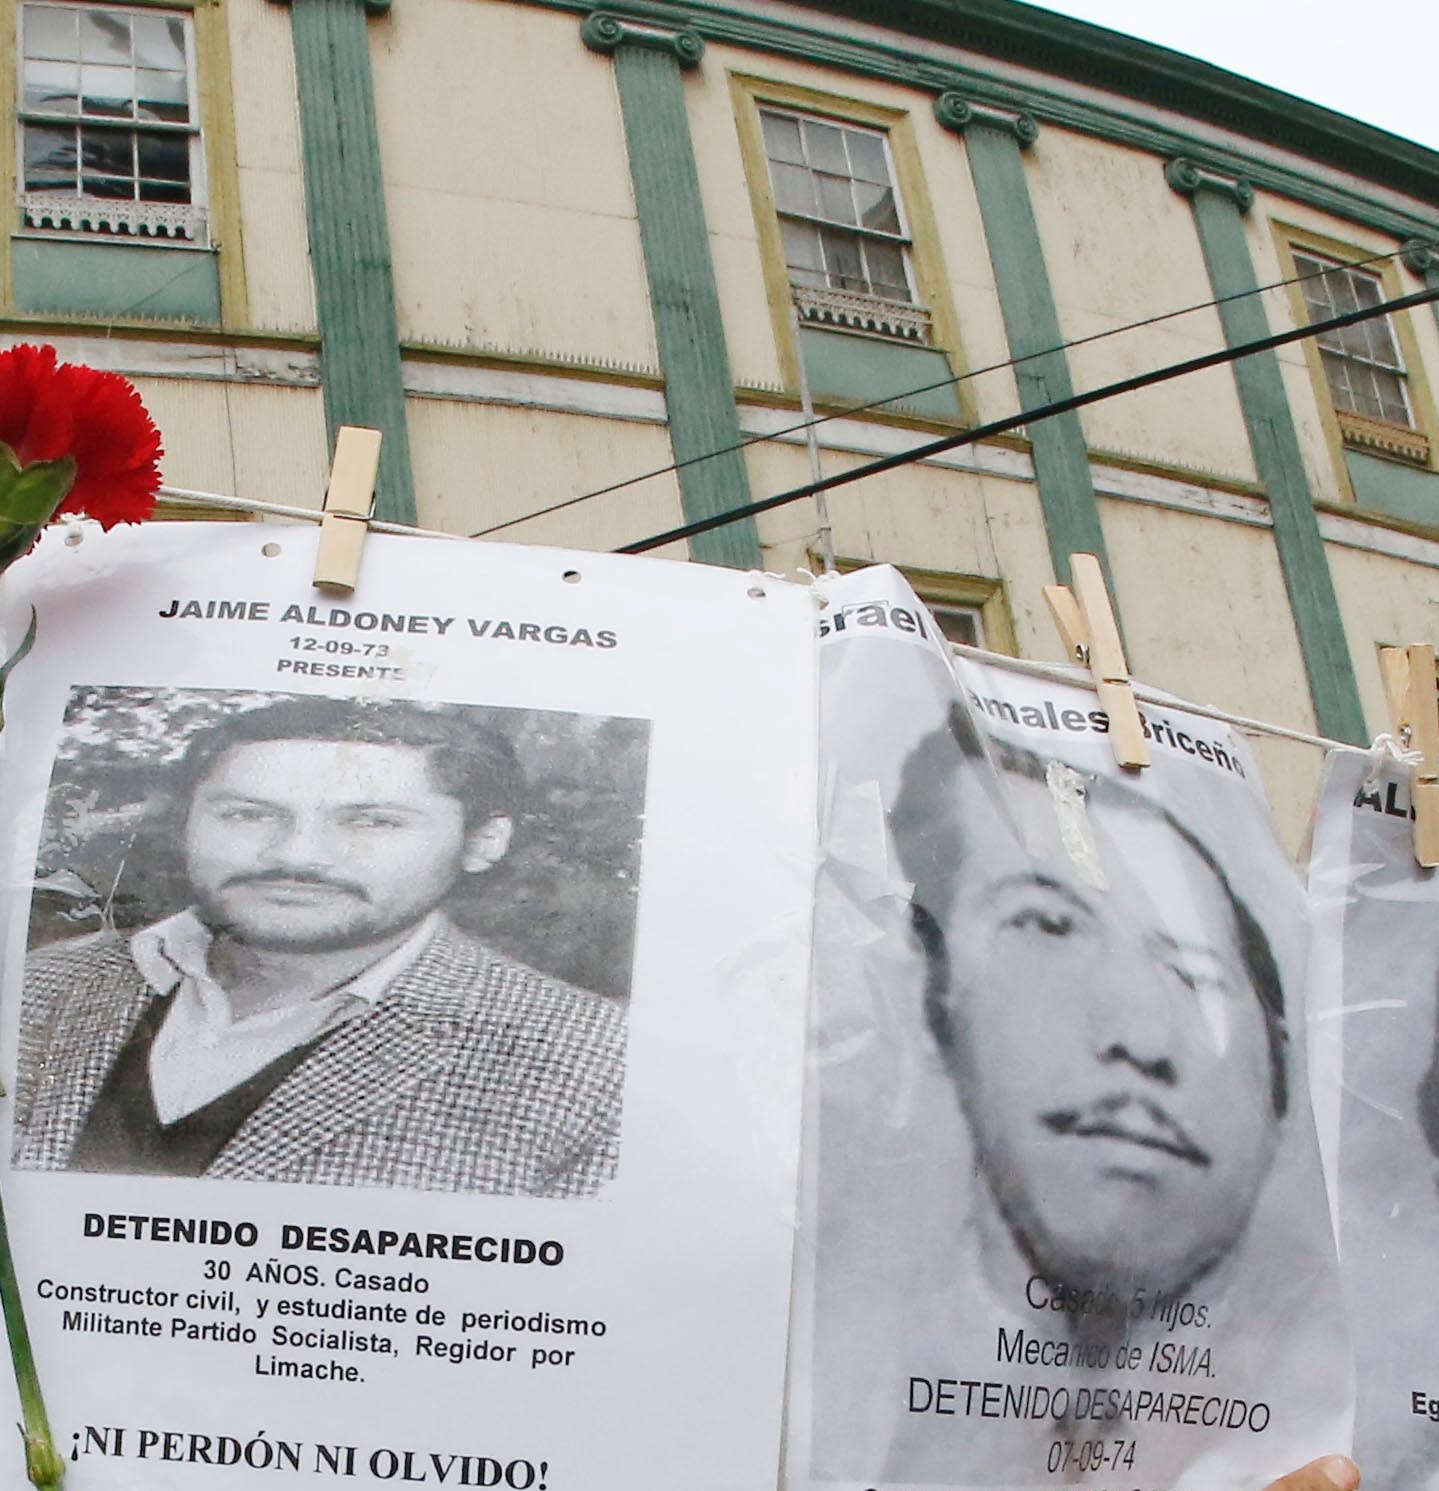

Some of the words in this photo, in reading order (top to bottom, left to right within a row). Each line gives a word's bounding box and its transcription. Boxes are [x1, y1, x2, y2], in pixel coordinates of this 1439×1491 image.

[159, 599, 271, 622] JAIME
[280, 603, 455, 636] ALDONEY
[467, 617, 619, 650] VARGAS
[290, 635, 391, 659] 12-09-73
[83, 1212, 259, 1248] DETENIDO
[281, 1223, 566, 1268] DESAPARECIDO
[203, 1260, 231, 1282] 30
[246, 1257, 326, 1290] AÑOS.
[335, 1268, 430, 1296] Casado
[37, 1279, 179, 1310] Constructor
[185, 1289, 241, 1317] civil,
[256, 1298, 270, 1319] y
[277, 1296, 408, 1325] estudiante
[415, 1304, 446, 1328] de
[461, 1309, 608, 1340] periodismo
[1151, 1290, 1212, 1332] hijos.
[61, 1310, 164, 1340] Militante
[170, 1318, 257, 1346] Partido
[271, 1323, 400, 1359] Socialista,
[415, 1334, 517, 1366] Regidor
[530, 1345, 576, 1370] por
[1114, 1339, 1143, 1371] de
[1148, 1340, 1217, 1379] ISMA.
[255, 1354, 367, 1385] Limache.
[909, 1376, 1070, 1421] DETENIDO
[1074, 1386, 1270, 1433] DESAPARECIDO
[70, 1425, 126, 1463] ¡NI
[137, 1430, 303, 1472] PERDÓN
[314, 1445, 358, 1477] NI
[1046, 1439, 1138, 1474] 07-09-74
